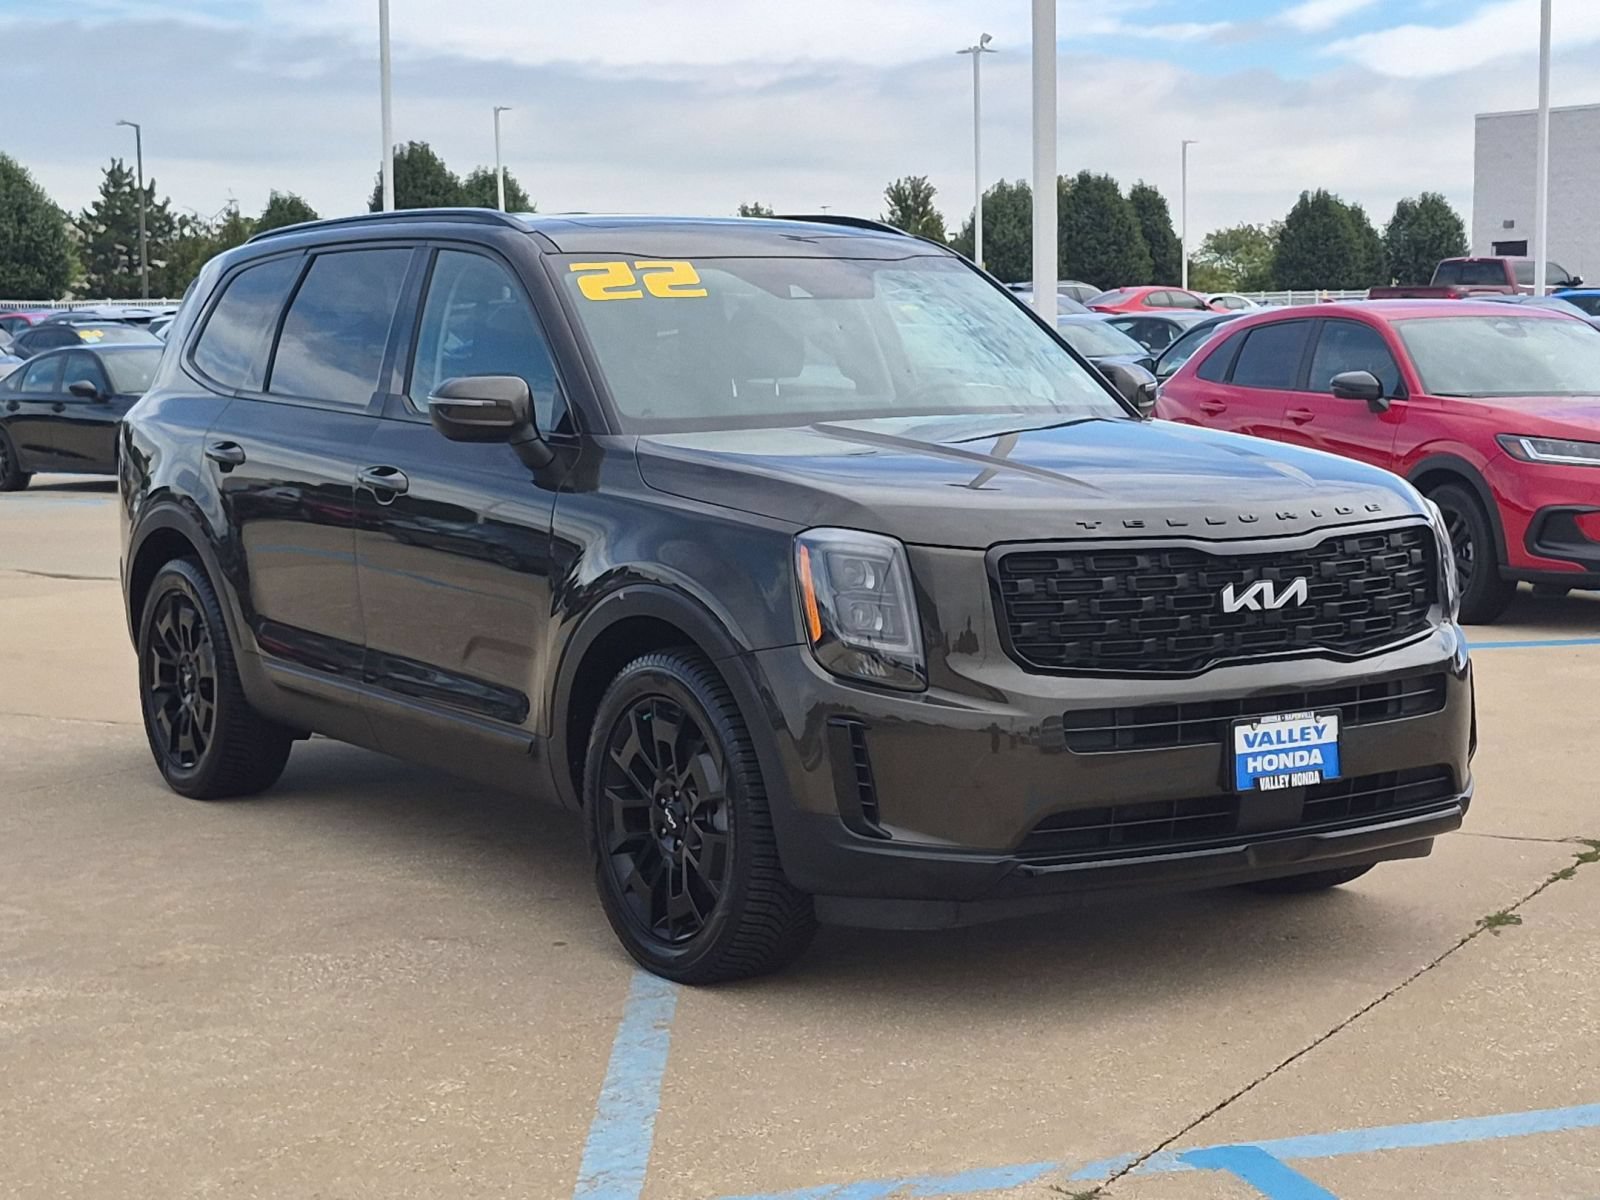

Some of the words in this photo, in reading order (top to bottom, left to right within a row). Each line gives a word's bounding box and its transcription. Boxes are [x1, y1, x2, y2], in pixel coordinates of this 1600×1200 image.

[569, 261, 708, 301] 22
[1076, 503, 1382, 529] TELLURIDE
[1221, 577, 1308, 613] KIA
[1243, 724, 1327, 748] VALLEY
[1247, 749, 1323, 773] HONDA
[1260, 774, 1290, 791] VALLEY
[1291, 771, 1320, 787] HONDA
